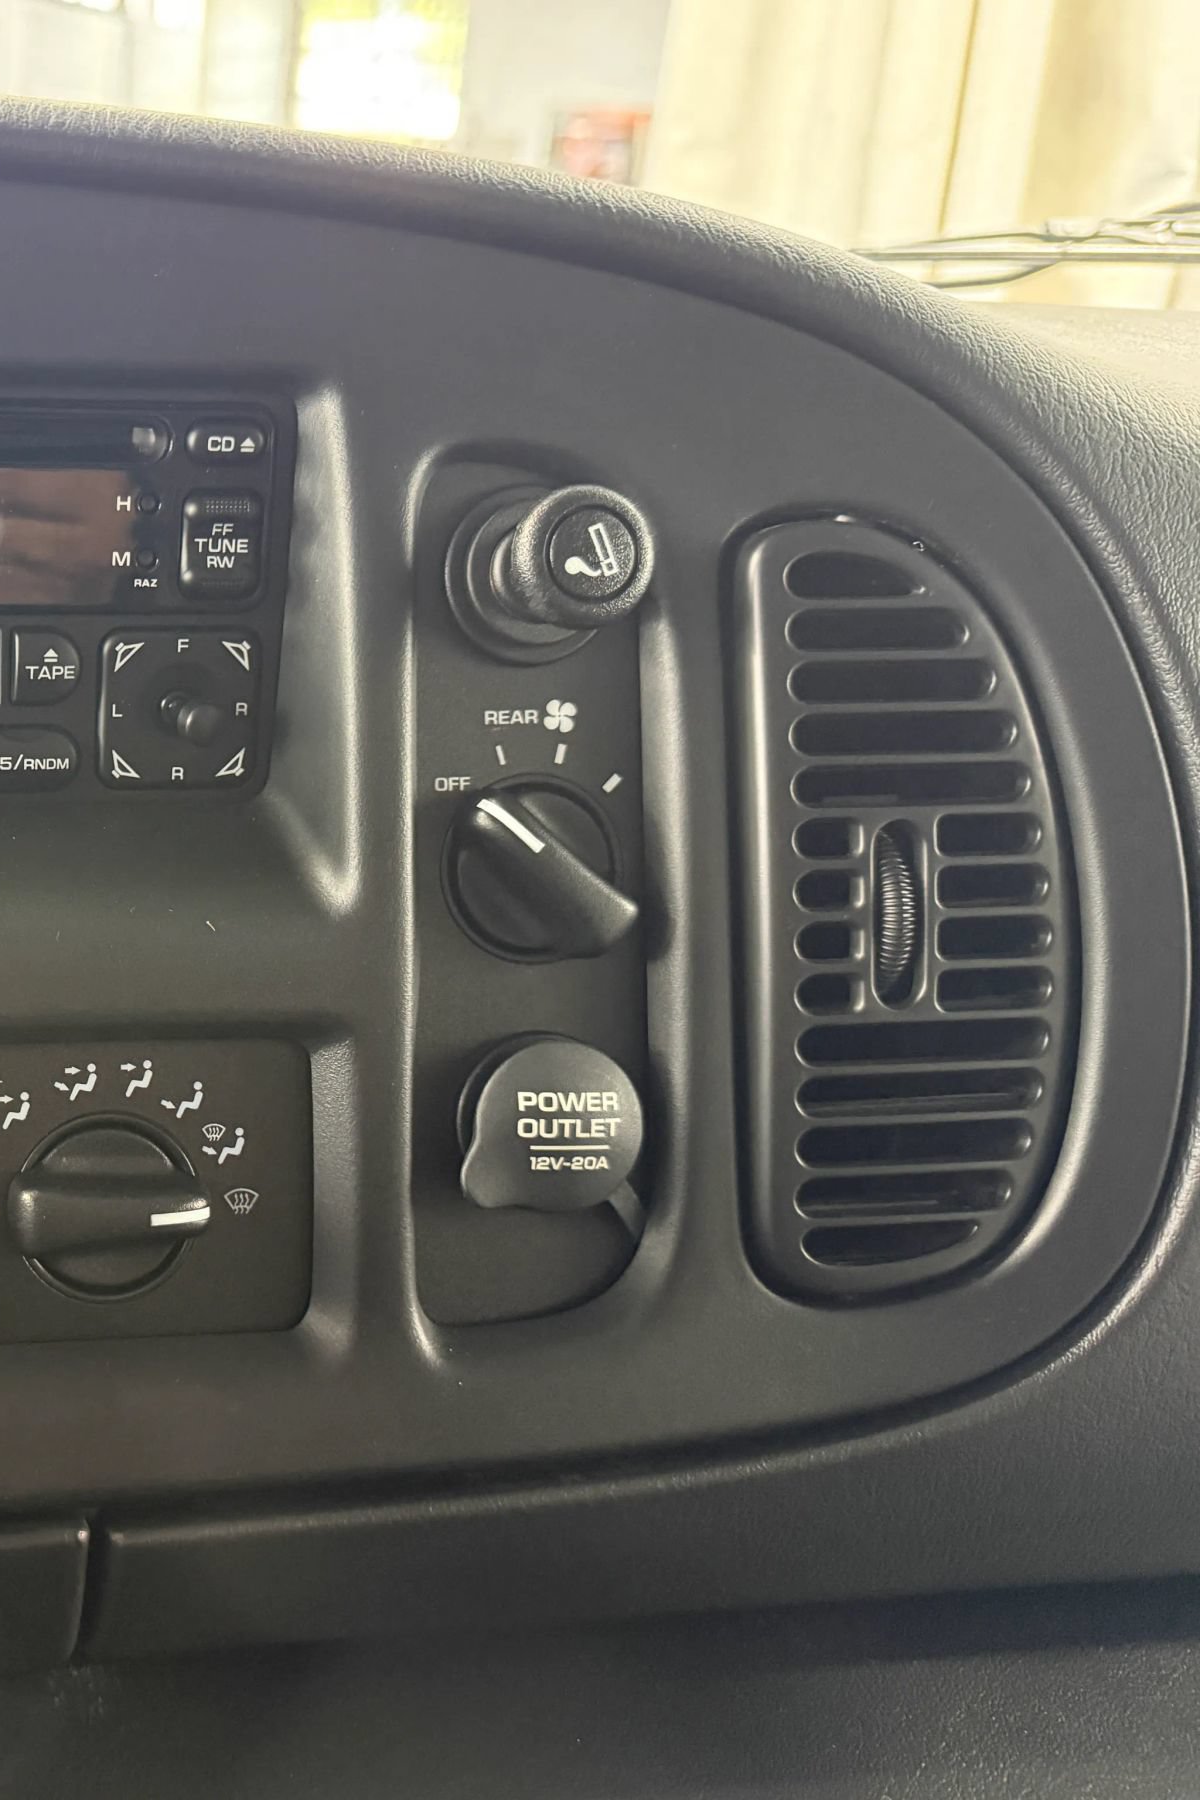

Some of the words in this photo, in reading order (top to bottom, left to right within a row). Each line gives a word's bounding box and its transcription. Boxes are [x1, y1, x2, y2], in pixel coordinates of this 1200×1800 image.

[207, 436, 236, 452] CD
[116, 496, 132, 512] H
[211, 523, 234, 536] FF
[194, 538, 249, 554] TUNE
[112, 552, 131, 567] M
[206, 555, 235, 569] RW
[134, 579, 158, 588] RAZ
[177, 639, 189, 653] F
[25, 665, 75, 680] TAPE
[112, 703, 123, 718] L
[235, 702, 247, 716] R
[484, 710, 539, 725] REAR
[0, 754, 70, 770] 5/RNDM
[171, 766, 184, 780] R
[435, 777, 471, 791] OFF
[517, 1091, 619, 1112] POWER
[517, 1118, 621, 1138] OUTLET
[530, 1156, 610, 1170] 12V-20A
